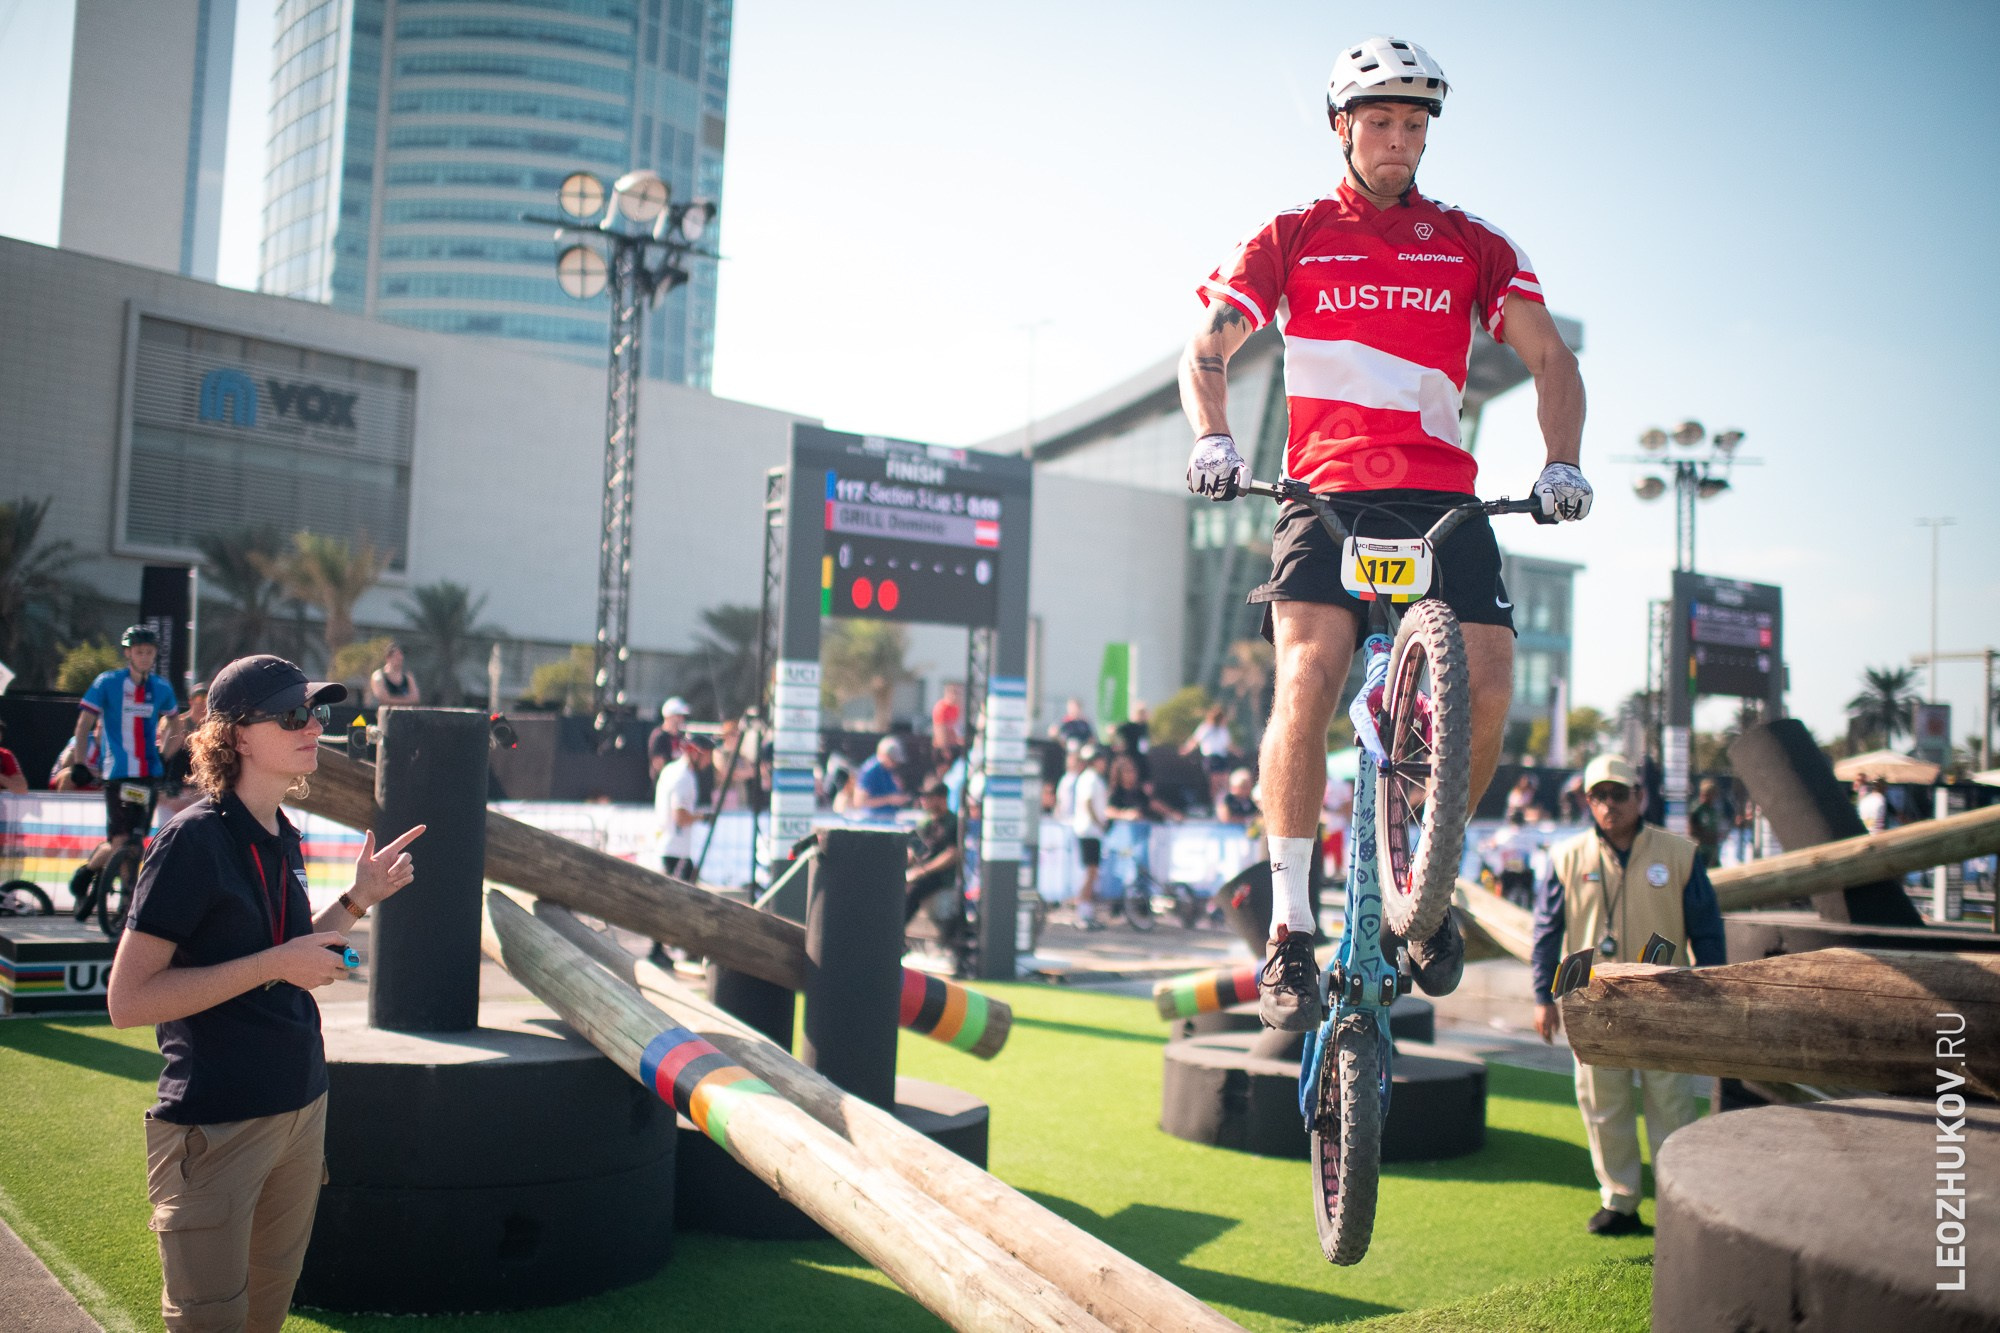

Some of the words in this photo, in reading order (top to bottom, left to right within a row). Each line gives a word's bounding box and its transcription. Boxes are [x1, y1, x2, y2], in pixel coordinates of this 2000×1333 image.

[1397, 252, 1464, 263] CHAOYANG
[1315, 285, 1451, 314] AUSTRIA
[267, 376, 360, 429] VOX
[886, 460, 945, 484] FINISH
[836, 480, 865, 502] 117
[840, 509, 883, 528] GRILL
[1367, 560, 1406, 584] 117
[786, 667, 816, 681] UCI
[782, 820, 812, 834] UCI
